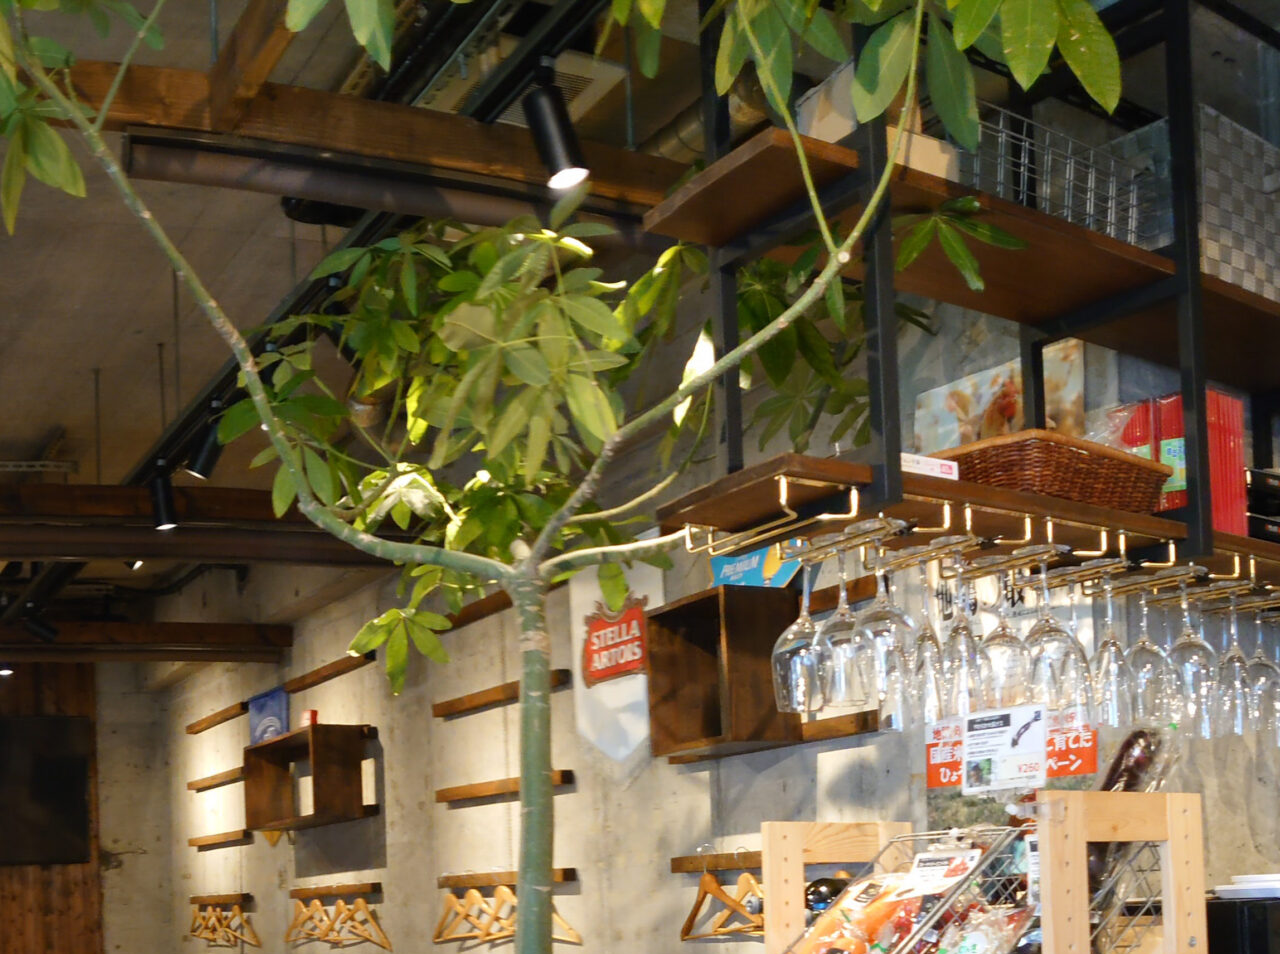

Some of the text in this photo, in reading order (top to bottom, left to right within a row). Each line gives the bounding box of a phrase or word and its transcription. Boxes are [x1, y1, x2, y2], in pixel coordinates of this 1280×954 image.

[720, 554, 760, 578] PREMIUM
[591, 619, 641, 650] STELLA
[591, 641, 643, 672] ARTOIS
